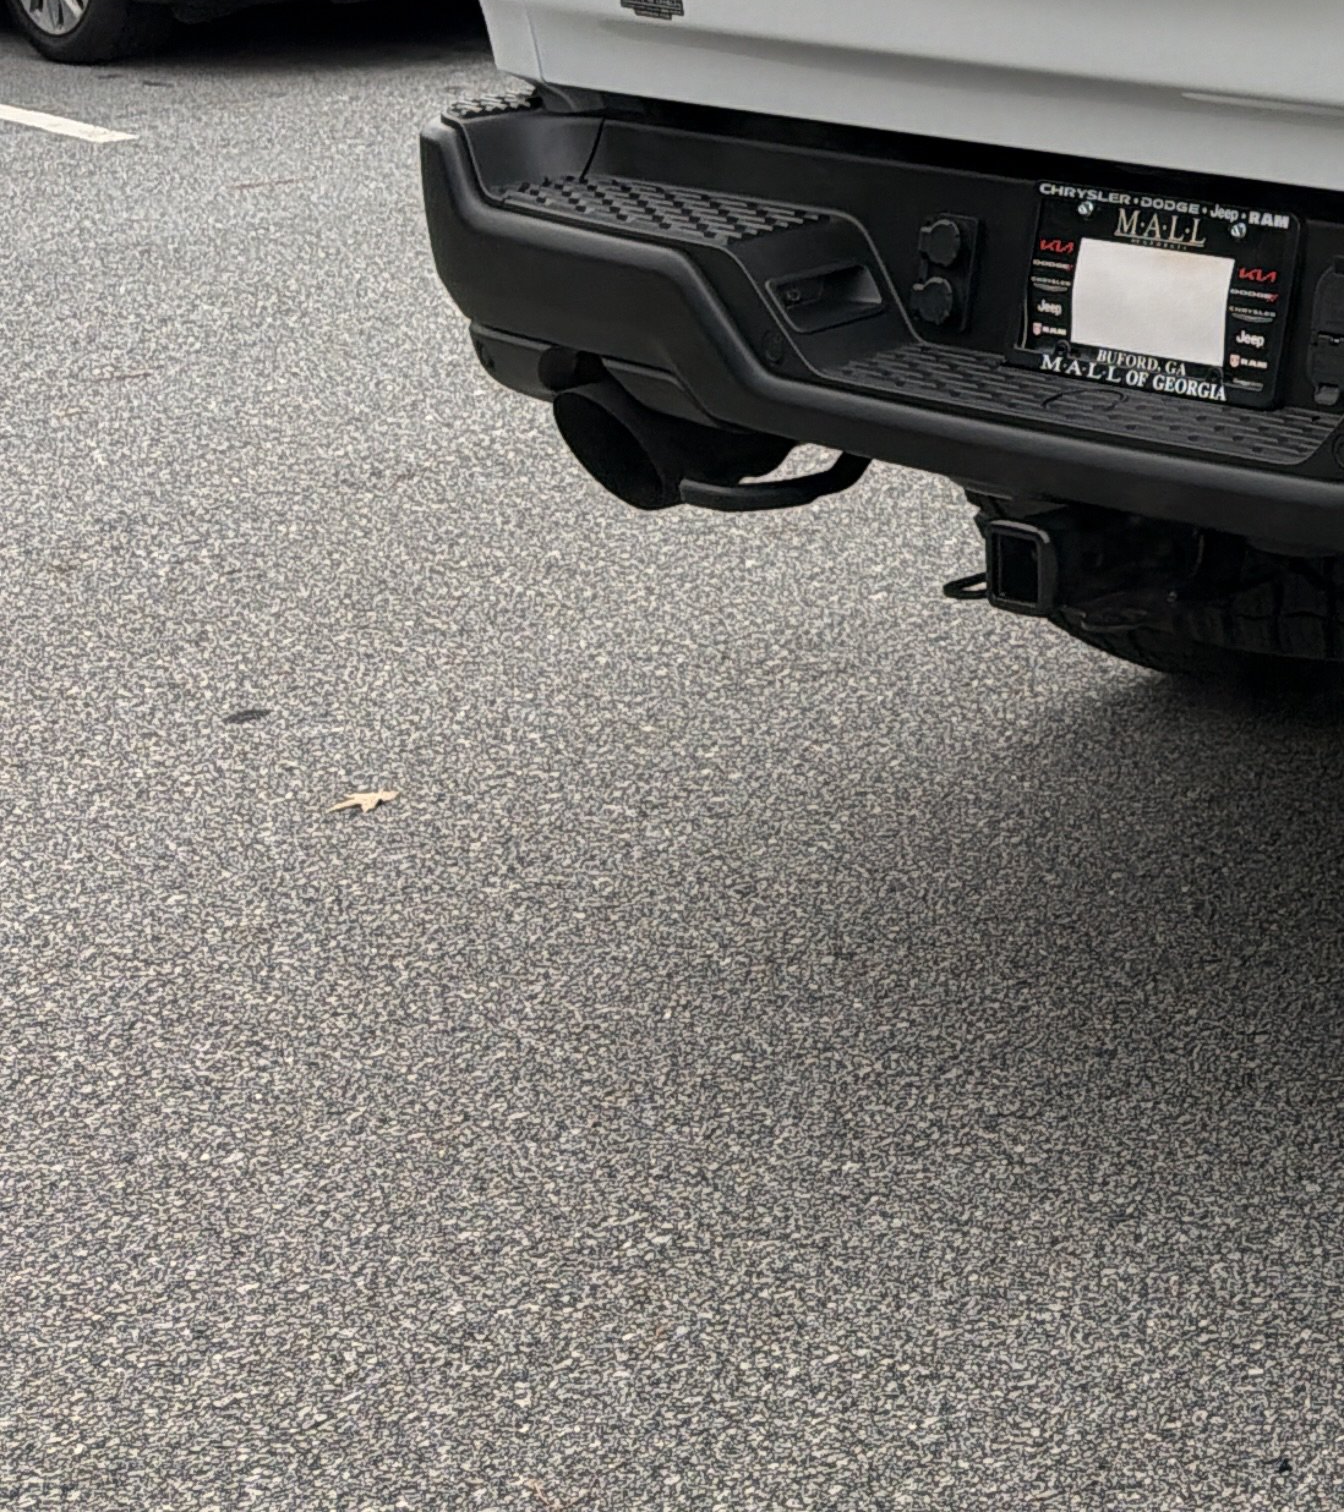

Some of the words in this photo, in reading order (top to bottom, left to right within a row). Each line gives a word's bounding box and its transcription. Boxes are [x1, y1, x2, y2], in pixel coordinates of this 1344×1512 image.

[1039, 182, 1131, 205] CHRYSLER
[1140, 197, 1200, 215] DODGE
[1210, 203, 1238, 222] Jeep
[1248, 210, 1290, 230] RAM
[1238, 267, 1277, 283] KIA
[1037, 298, 1062, 316] Jeep
[1235, 330, 1265, 349] Jeep
[1096, 348, 1162, 375] BUFORD,
[1165, 359, 1187, 376] GA
[1125, 369, 1147, 388] OF
[1152, 372, 1227, 401] GEORGIA
